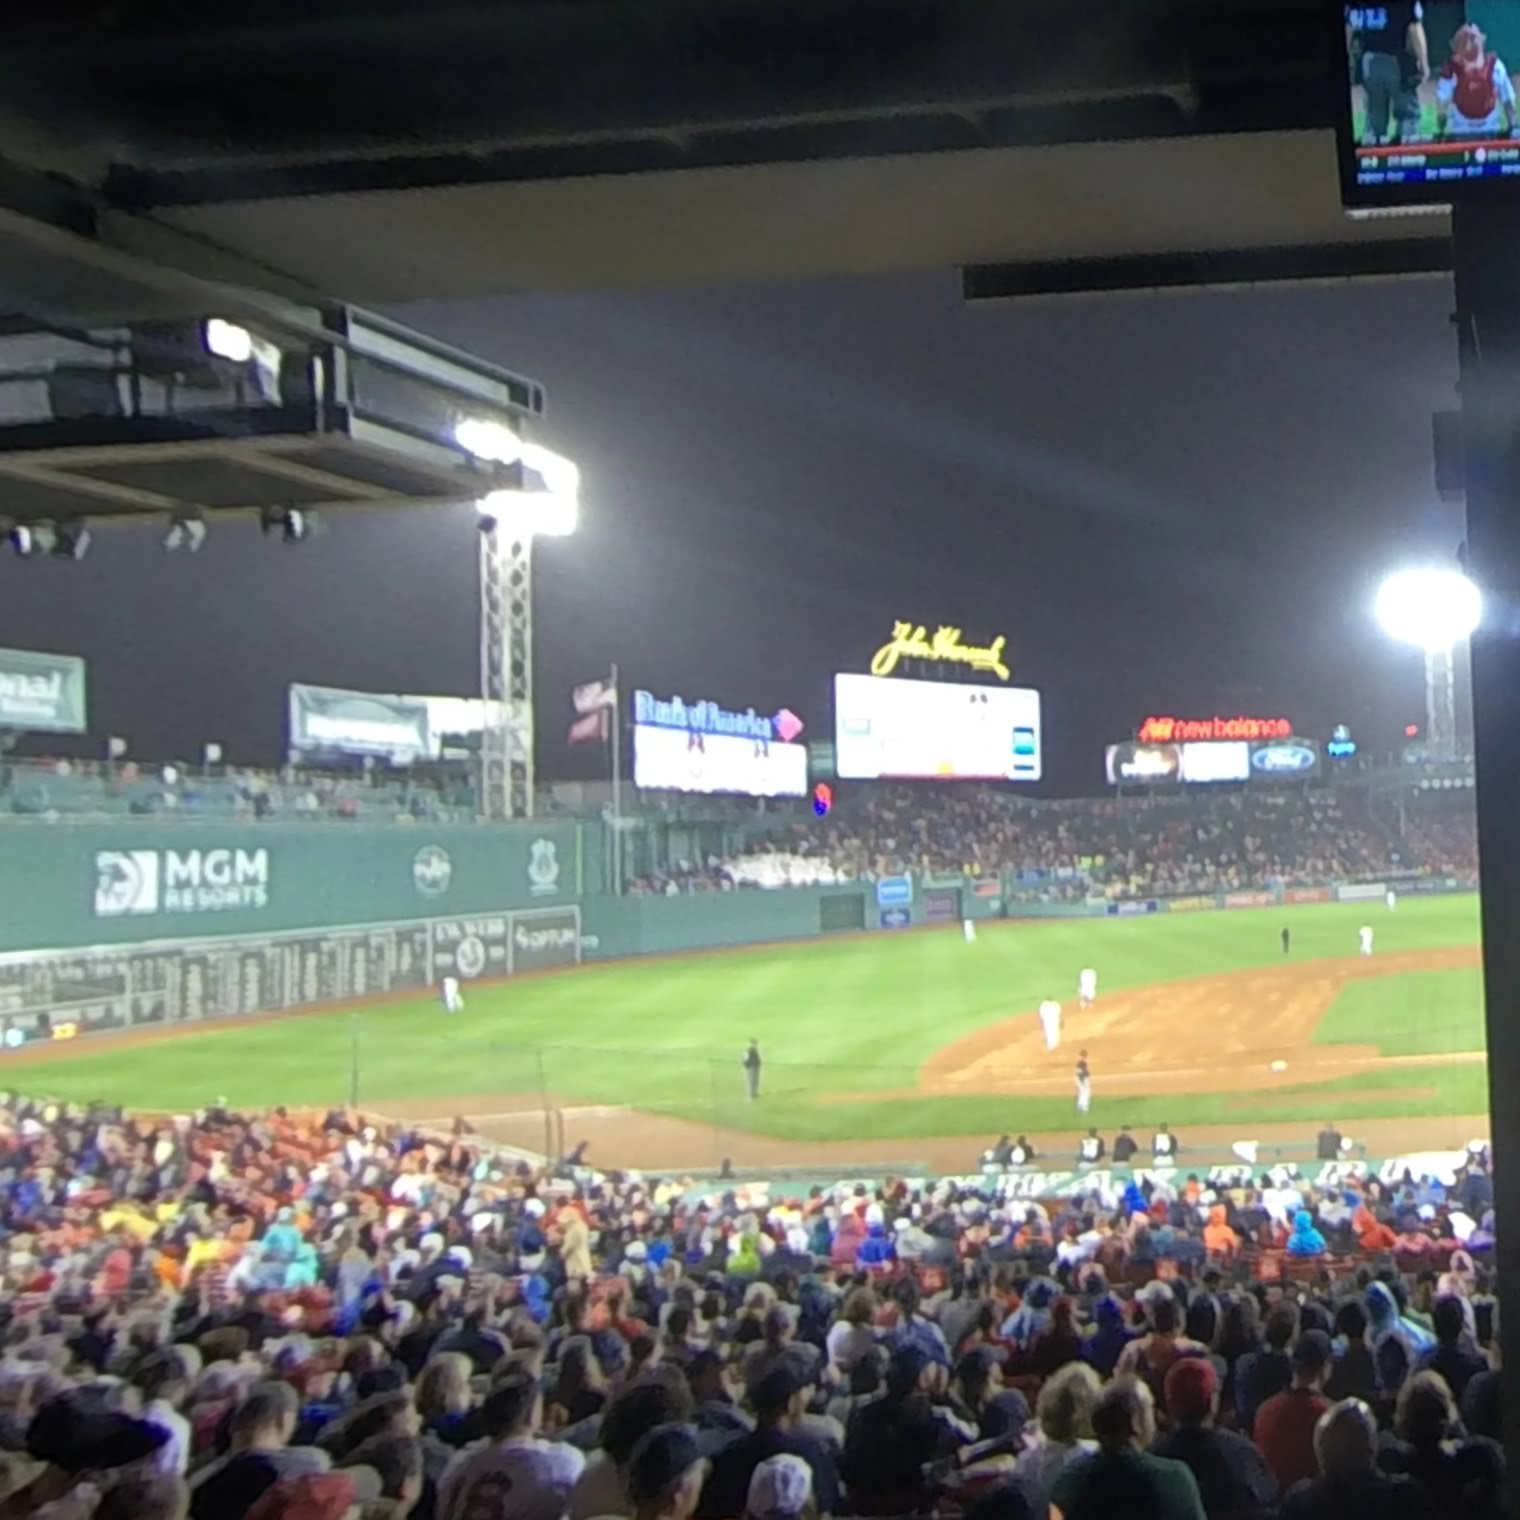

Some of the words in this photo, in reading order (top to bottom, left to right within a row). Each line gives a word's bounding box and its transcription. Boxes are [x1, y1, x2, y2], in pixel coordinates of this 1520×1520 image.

[634, 689, 687, 728] Bank
[688, 699, 707, 731] of
[706, 701, 772, 740] America
[1175, 718, 1212, 741] new
[1213, 716, 1292, 740] balance
[165, 847, 269, 888] MGM
[164, 882, 269, 913] RESORTS
